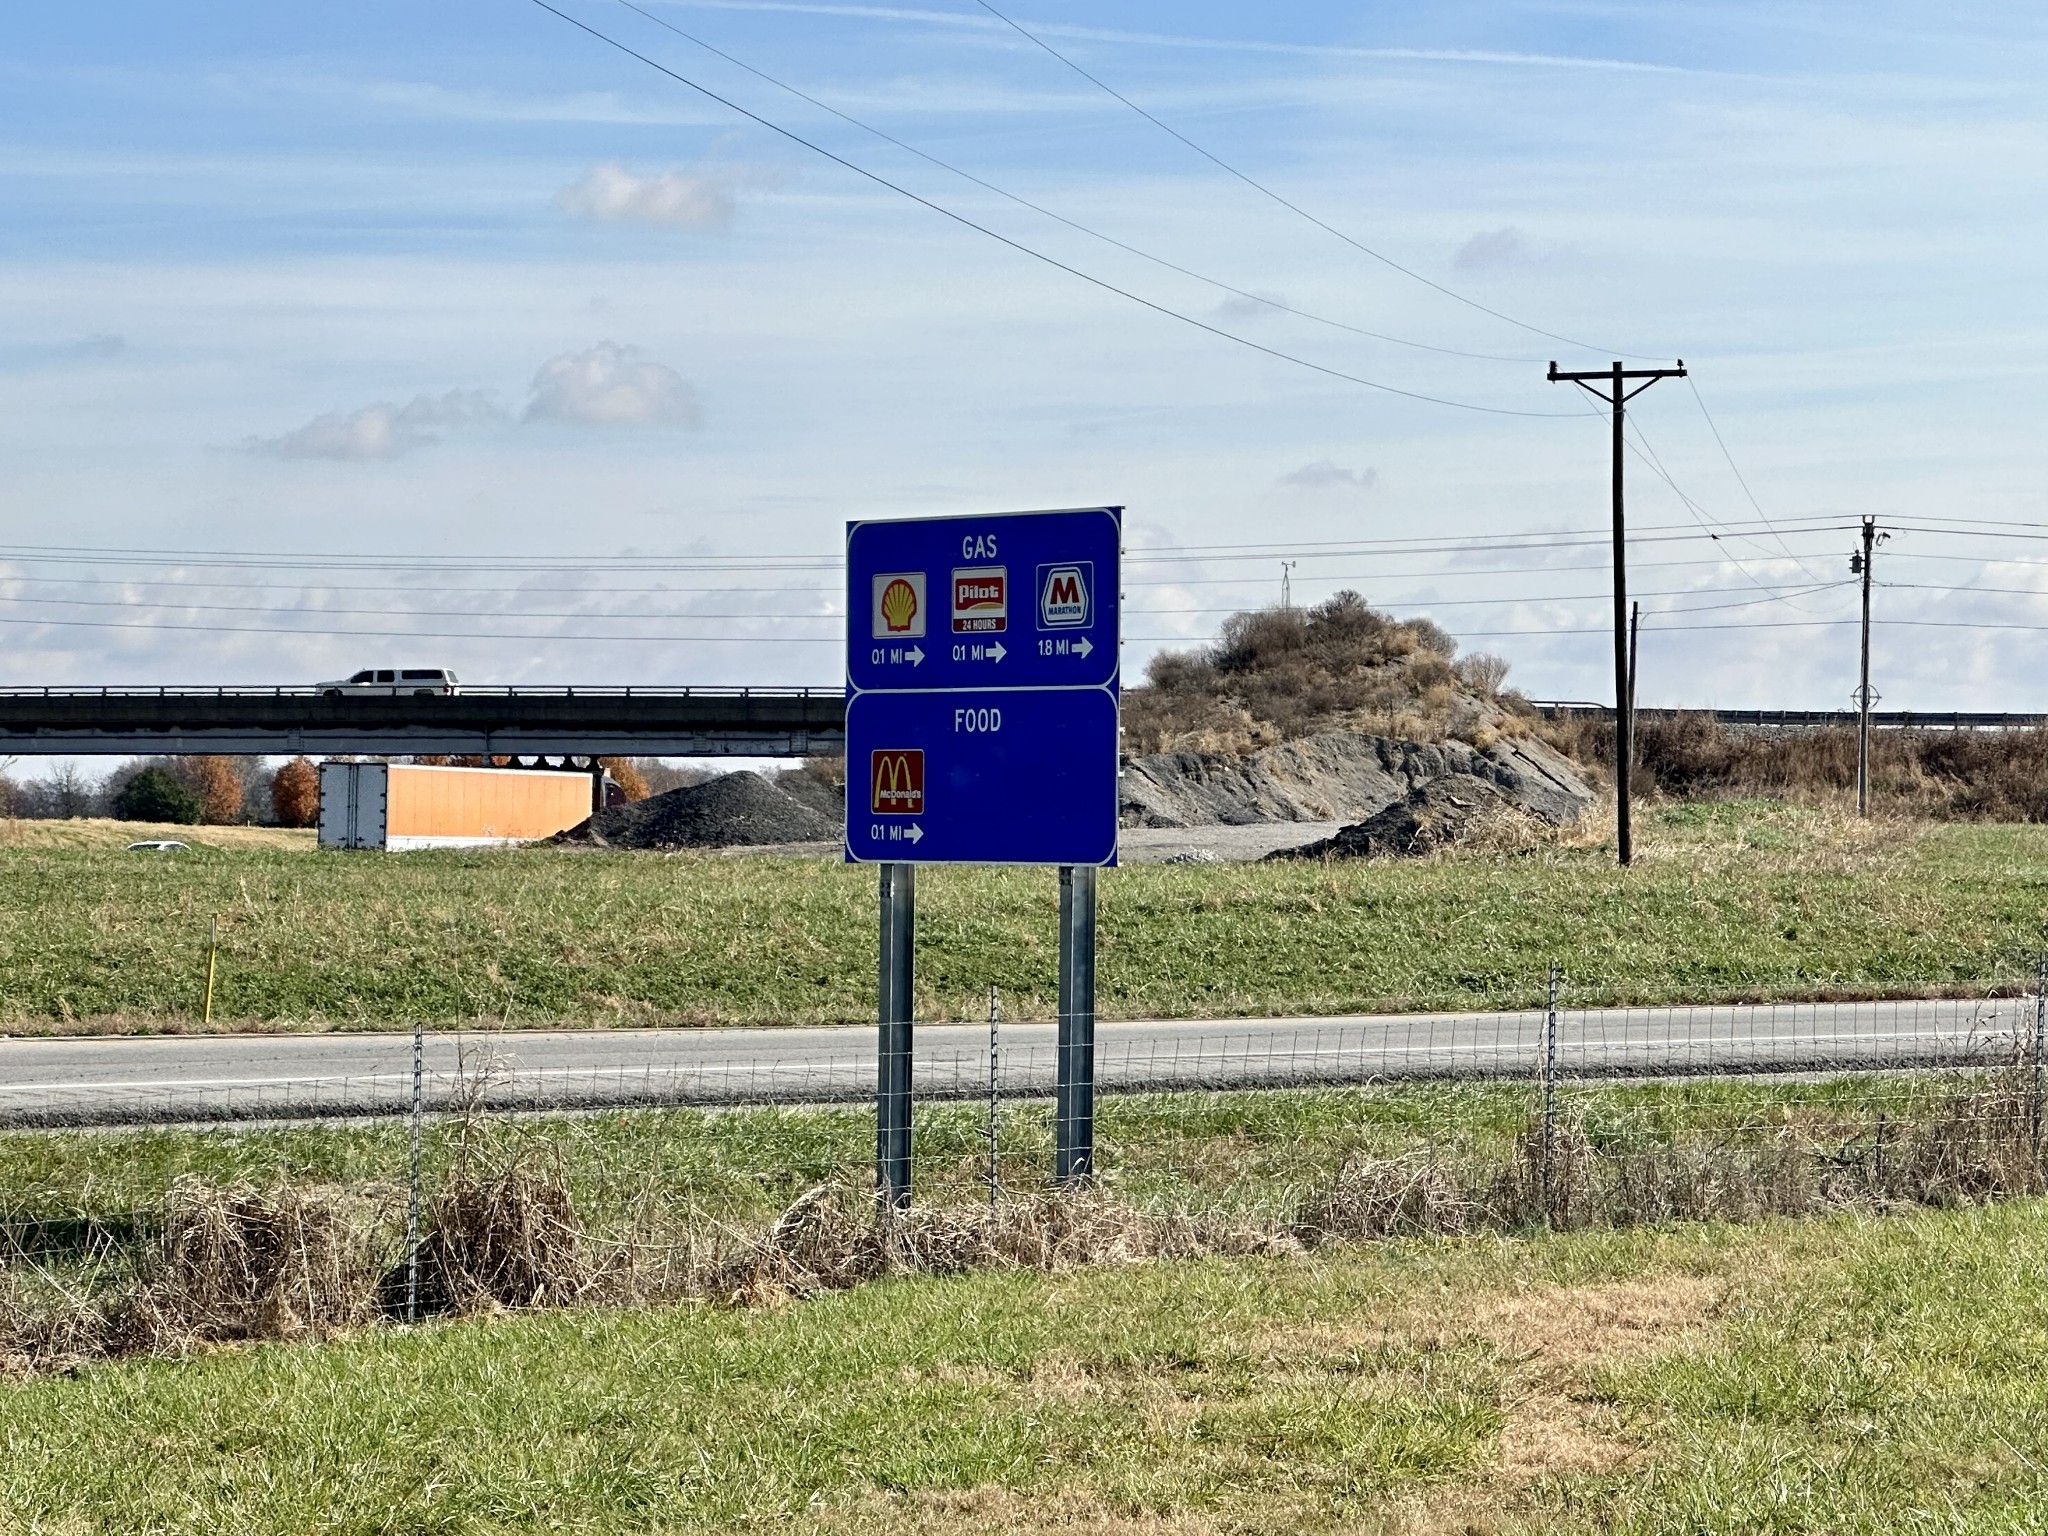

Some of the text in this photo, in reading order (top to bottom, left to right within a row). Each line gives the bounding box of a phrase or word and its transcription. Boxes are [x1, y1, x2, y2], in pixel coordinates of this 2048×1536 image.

[962, 534, 998, 560] GAS
[1048, 604, 1082, 616] MARATHON
[962, 618, 997, 631] 24 HOURS
[952, 644, 984, 661] 0.1 MI
[1038, 638, 1070, 656] 1.8 MI
[871, 648, 903, 665] 0.1 MI
[955, 708, 1002, 733] FOOD
[880, 789, 922, 799] McDonald's
[871, 824, 902, 841] 0.1 MI
